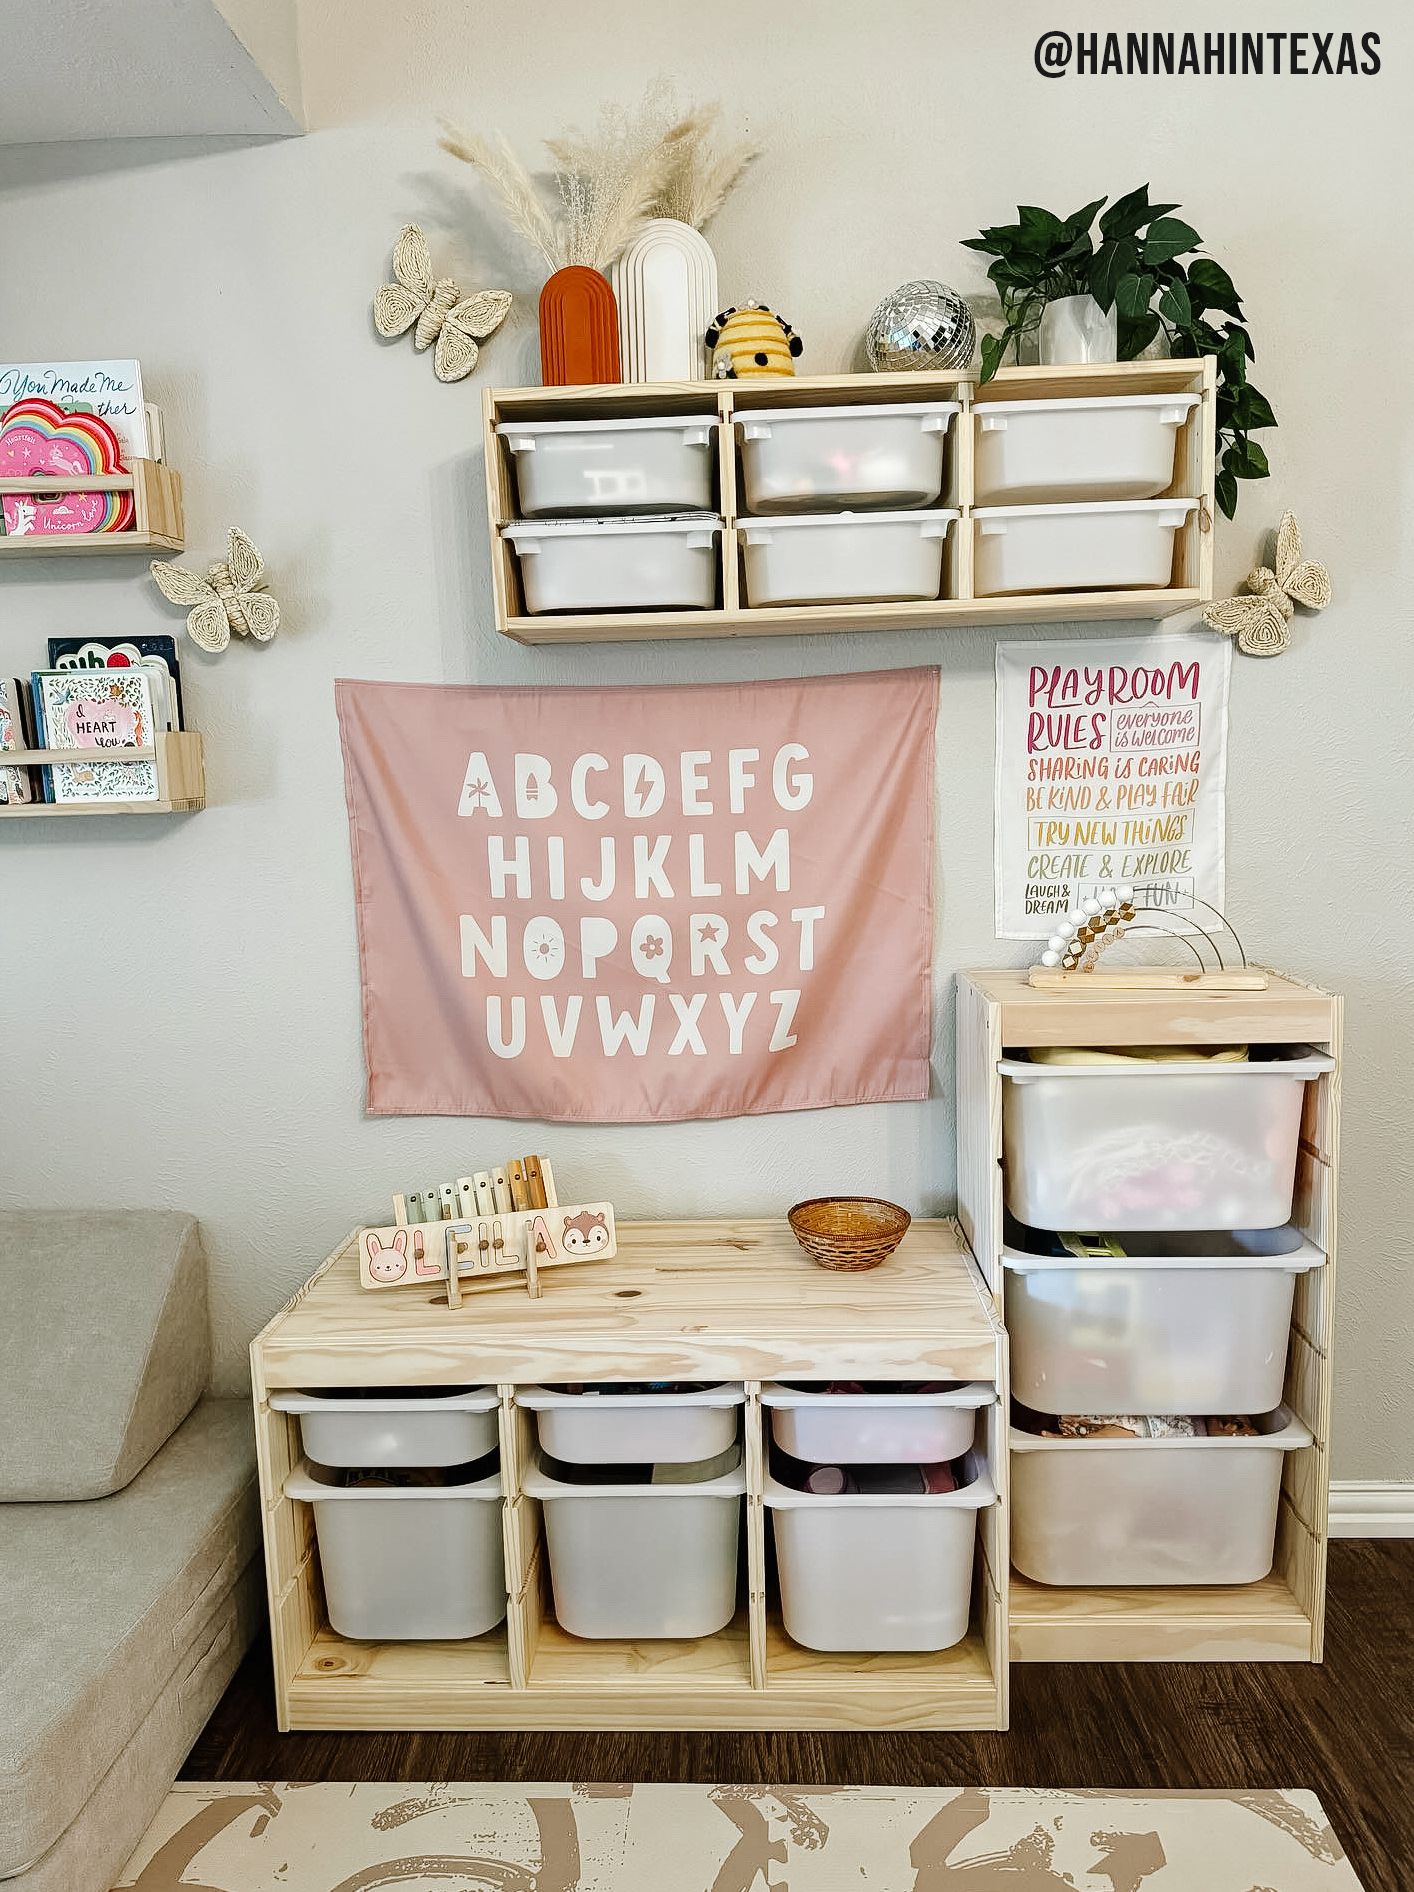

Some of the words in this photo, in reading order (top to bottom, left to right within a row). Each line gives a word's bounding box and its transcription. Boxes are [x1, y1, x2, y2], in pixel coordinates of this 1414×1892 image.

[0, 369, 48, 402] You
[44, 370, 97, 394] Made
[95, 372, 134, 392] Me
[43, 516, 84, 530] Unicorn
[1029, 661, 1200, 709] PLAYROOM
[76, 721, 117, 734] HEART
[1027, 711, 1107, 754] RULES
[1117, 709, 1193, 730] everyone
[1114, 731, 1129, 747] is
[1131, 726, 1195, 747] welcome
[1026, 786, 1045, 811] BE
[1095, 786, 1112, 811] &
[1117, 783, 1157, 810] PLAY
[1033, 821, 1070, 847] TRY
[1073, 821, 1117, 846] NEW
[1027, 854, 1094, 880] CREATE
[1099, 854, 1113, 878] &
[1121, 849, 1193, 878] EXPLORE
[1025, 898, 1069, 915] DREAM
[1143, 882, 1180, 907] FUN
[413, 1215, 557, 1276] LEILA
